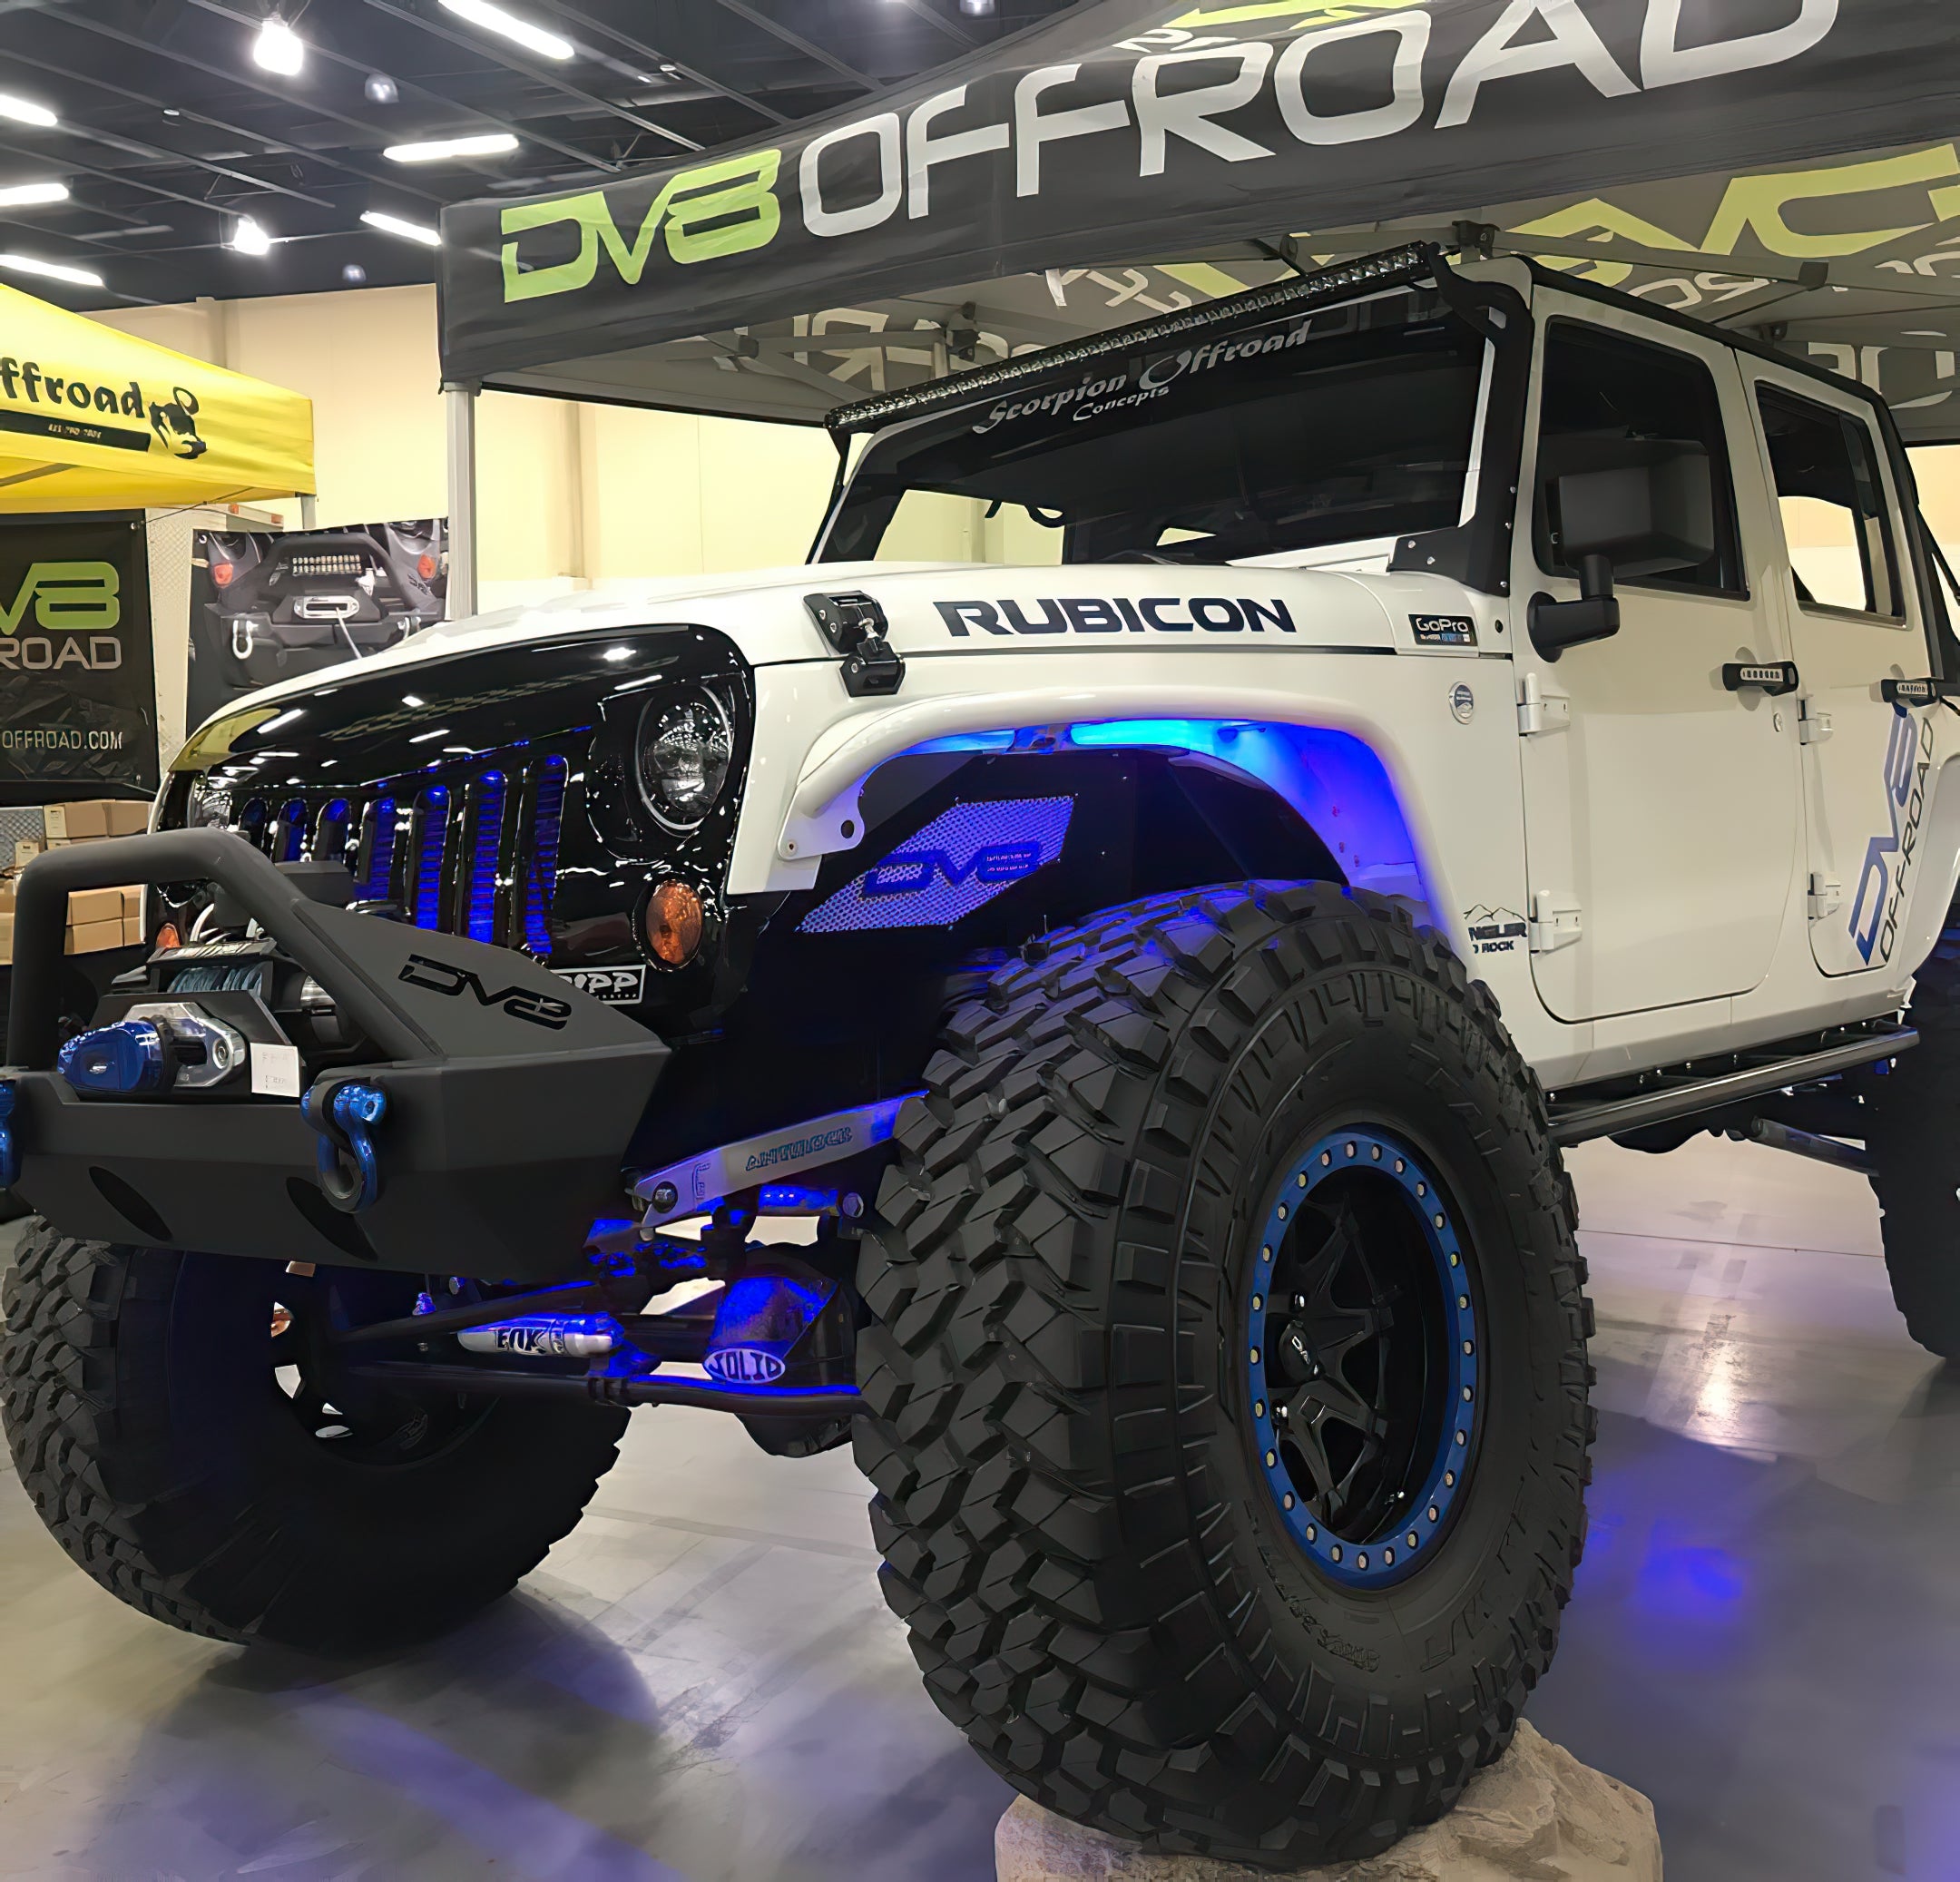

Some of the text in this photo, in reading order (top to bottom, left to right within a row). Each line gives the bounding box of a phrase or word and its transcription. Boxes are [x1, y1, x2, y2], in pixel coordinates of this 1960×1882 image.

[501, 0, 1840, 304] DV8 OFFROAD
[972, 319, 1312, 434] Scorpion Offroad
[1073, 387, 1170, 422] Concepts
[932, 597, 1298, 637] RUBICON
[1416, 617, 1469, 632] GoPro
[1879, 716, 1934, 963] OFFROAD
